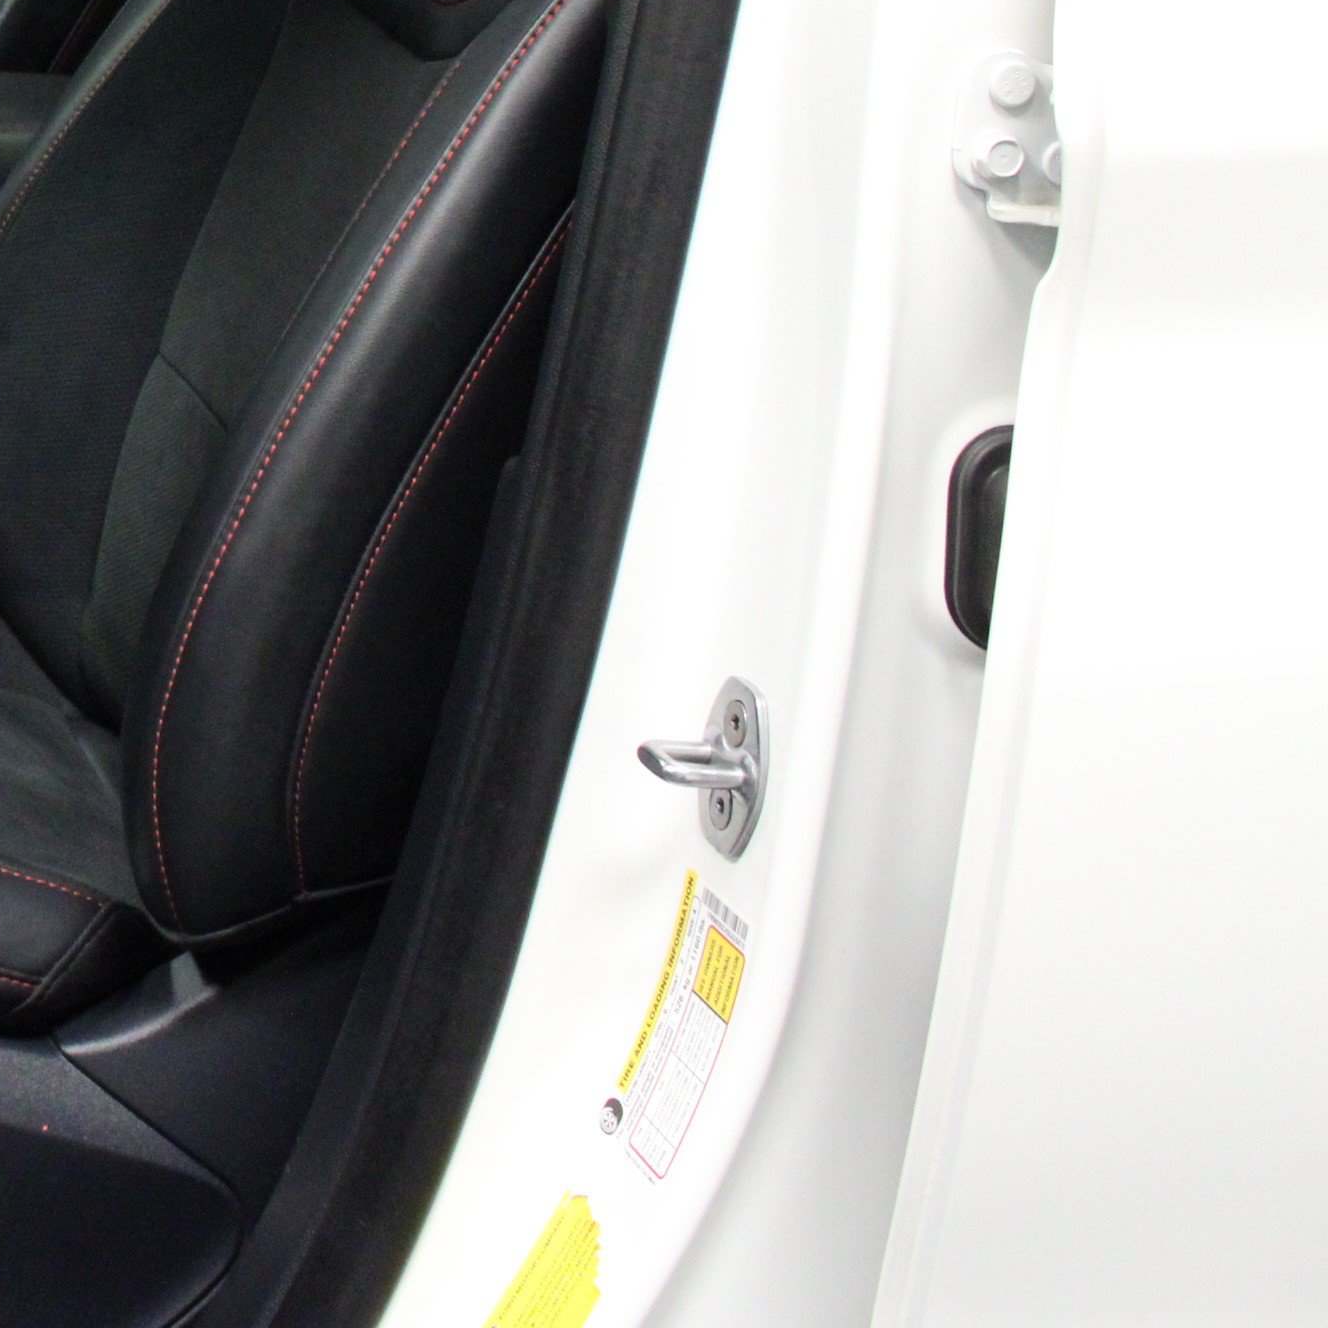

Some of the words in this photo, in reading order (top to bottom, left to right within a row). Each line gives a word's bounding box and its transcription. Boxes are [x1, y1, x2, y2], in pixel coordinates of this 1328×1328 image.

[618, 1060, 636, 1089] TIRE
[634, 1031, 648, 1058] AND
[646, 971, 670, 1029] LOADING
[668, 876, 694, 968] INFORMATION
[705, 967, 719, 1002] MANUAL
[714, 955, 731, 1006] ADDITIONAL
[721, 956, 740, 1015] INFORMATION
